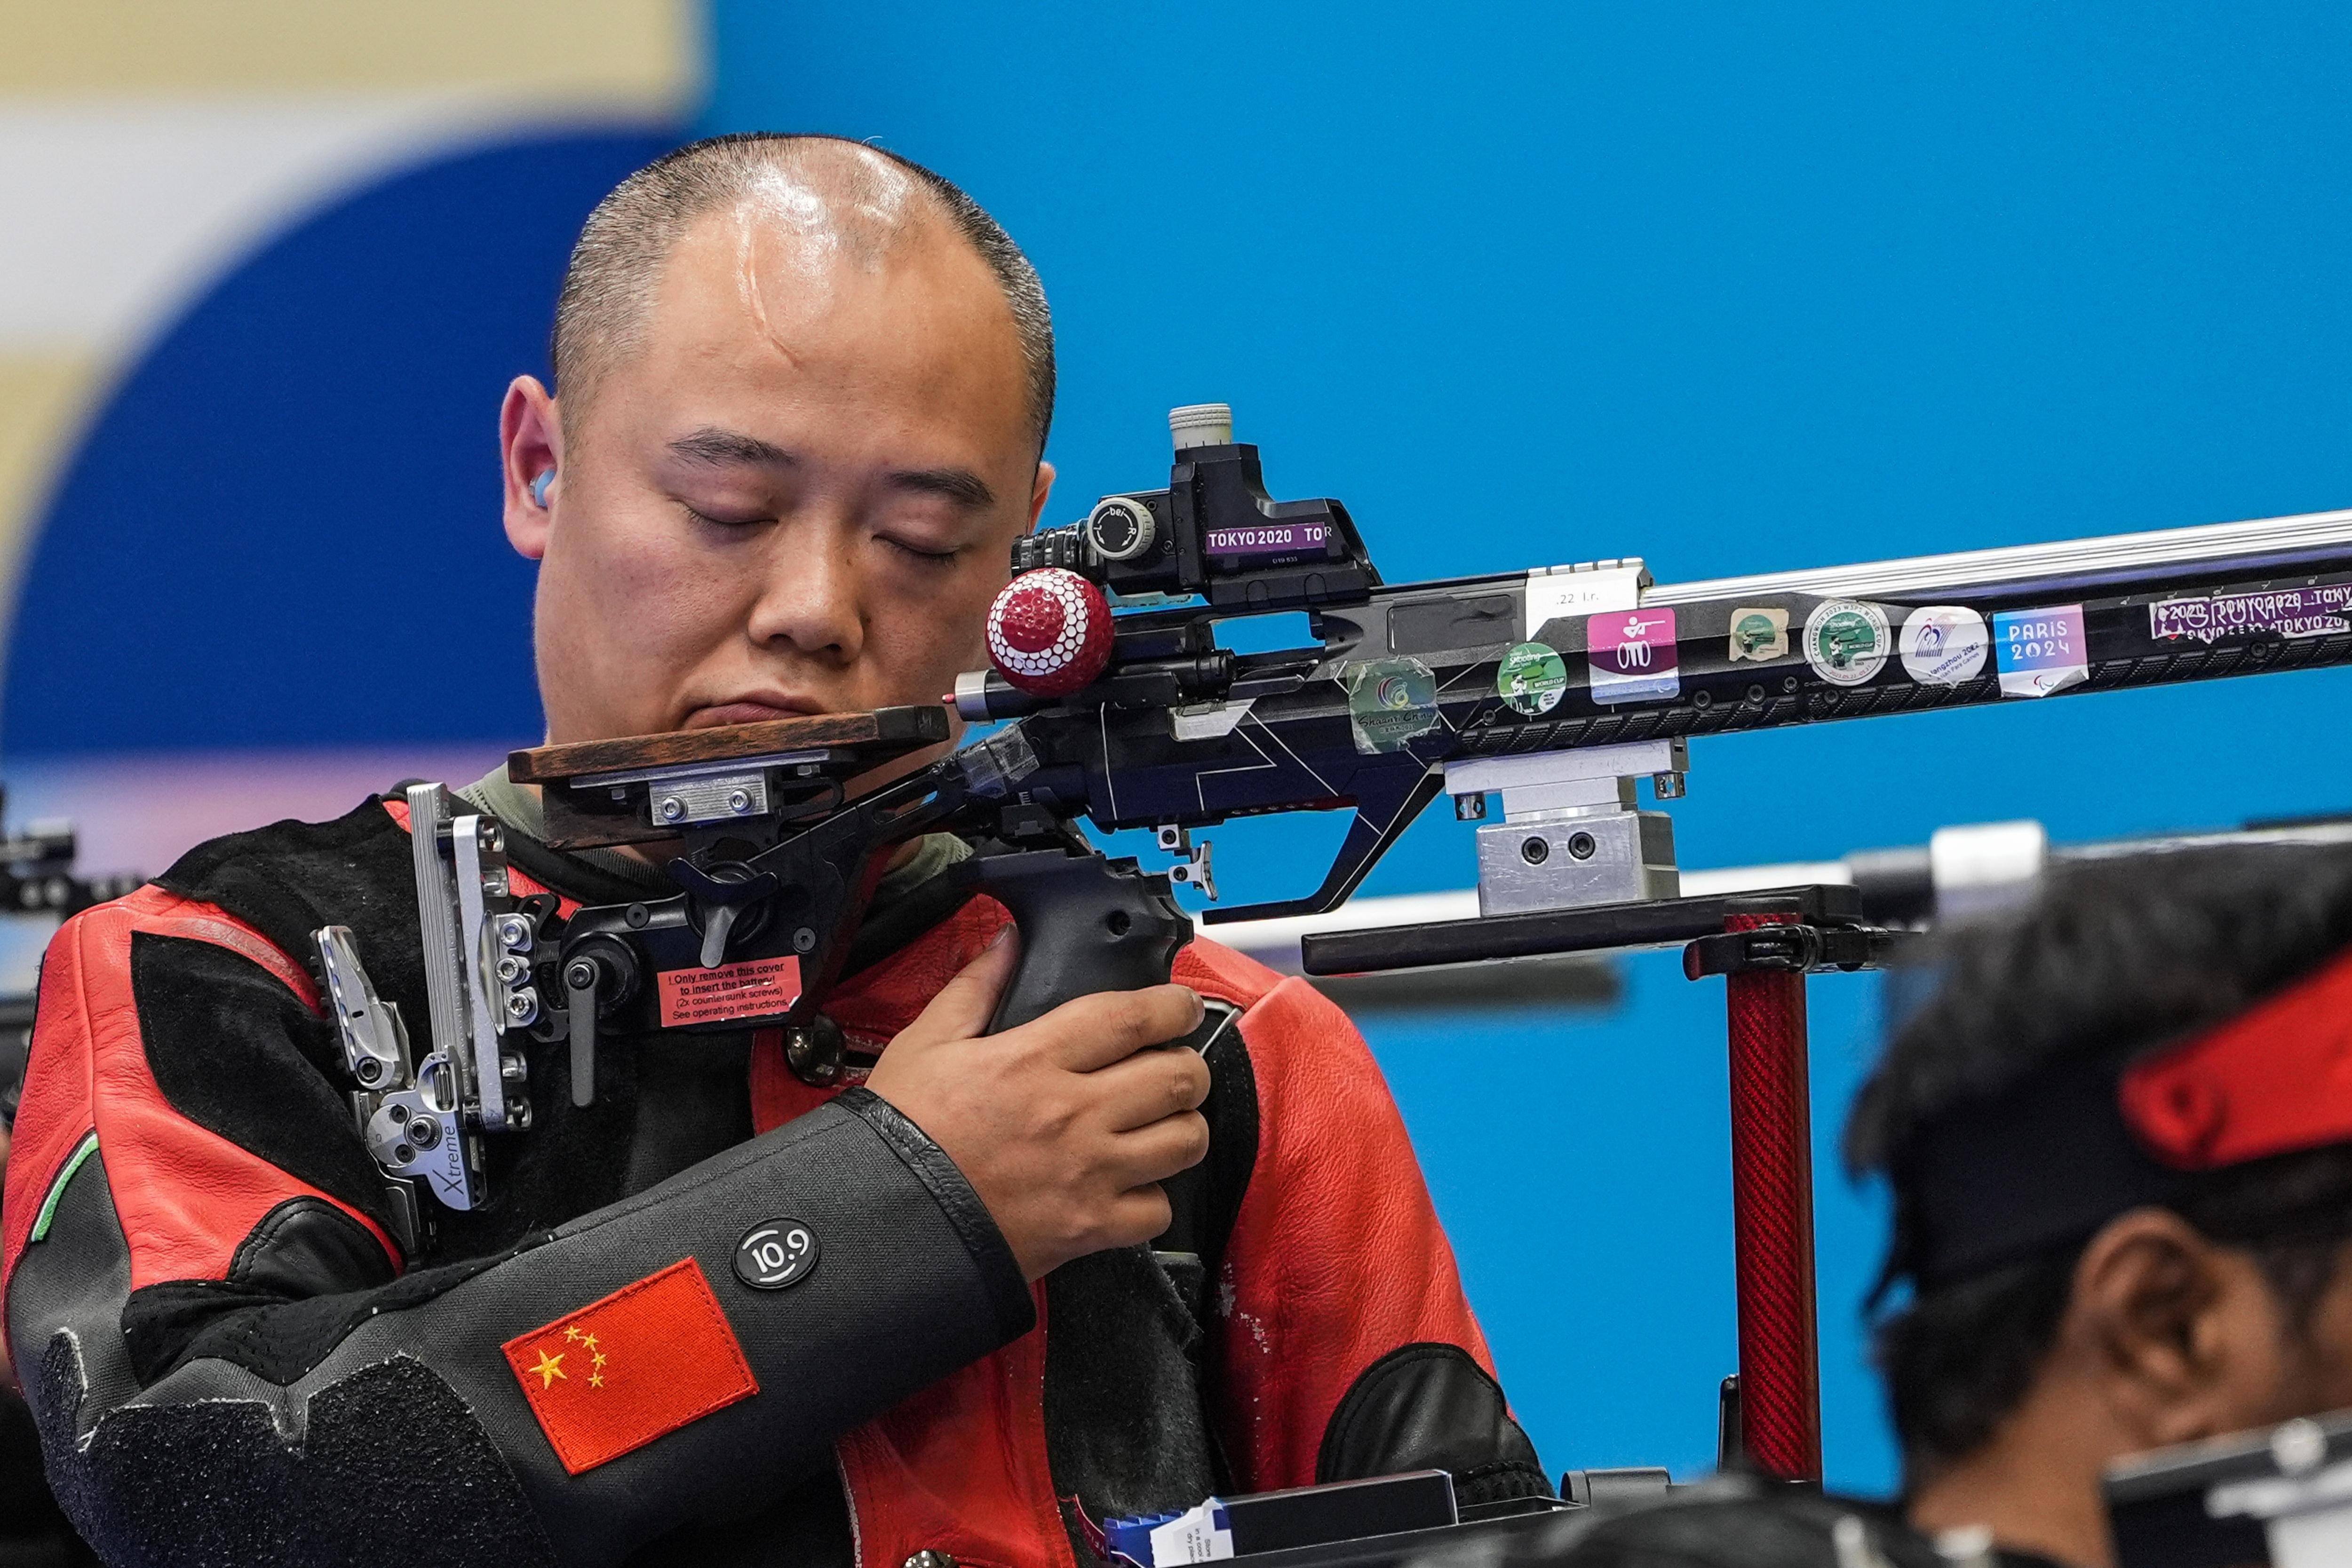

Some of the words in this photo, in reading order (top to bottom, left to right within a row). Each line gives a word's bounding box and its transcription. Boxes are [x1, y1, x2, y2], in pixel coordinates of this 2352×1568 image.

[1110, 507, 1126, 516] bei
[1208, 531, 1255, 547] TOKYO
[1258, 530, 1292, 544] 2020
[1557, 594, 1574, 604] .22
[2274, 616, 2322, 633] TOKYO
[2012, 639, 2070, 660] 2024
[675, 974, 696, 985] Only
[699, 970, 734, 981] remove
[737, 966, 755, 976] this
[757, 964, 784, 973] cover
[693, 983, 720, 994] insert
[722, 981, 737, 990] the
[739, 976, 775, 987] battery!
[692, 990, 747, 1005] countersunk
[749, 986, 783, 998] screws)
[673, 1011, 690, 1019] See
[693, 1006, 735, 1019] operating
[432, 1126, 464, 1195] Xtreme
[752, 1229, 809, 1273] 10.9
